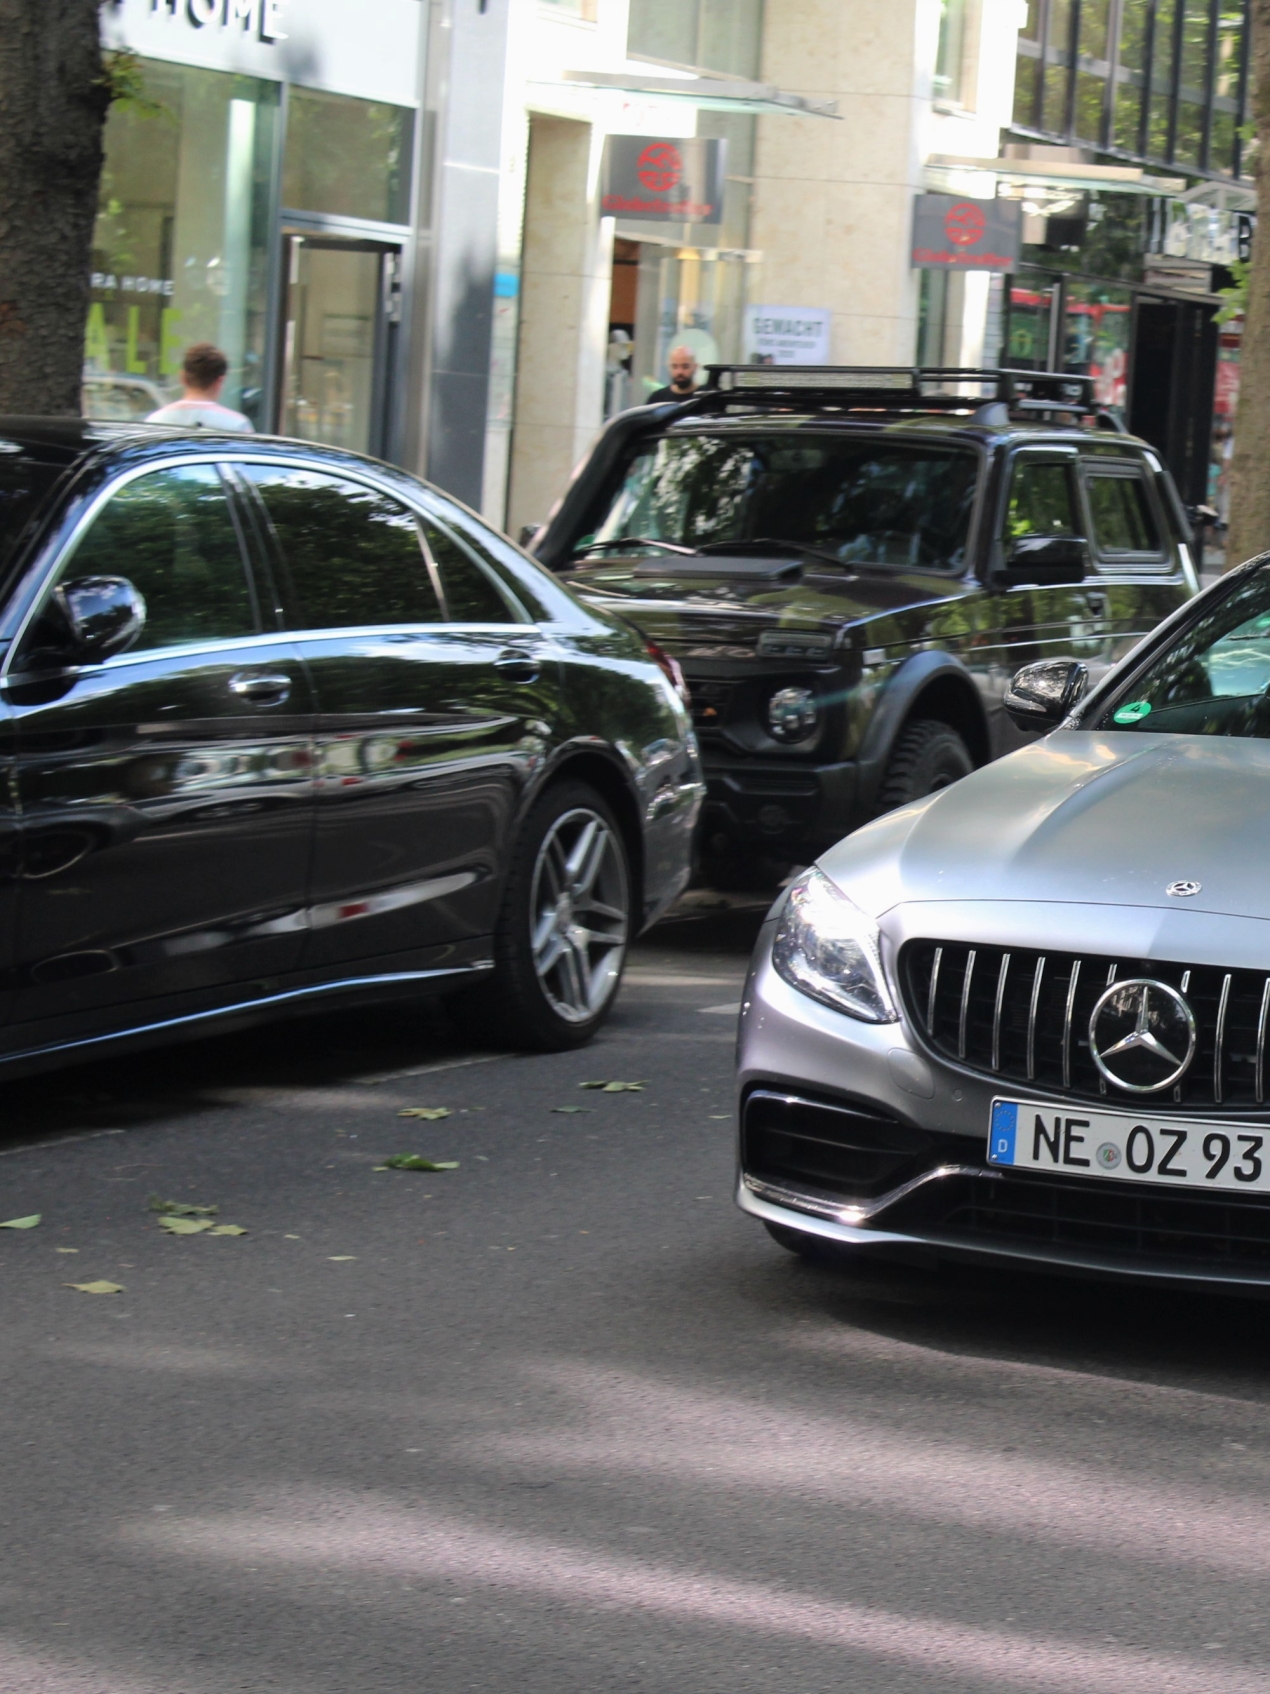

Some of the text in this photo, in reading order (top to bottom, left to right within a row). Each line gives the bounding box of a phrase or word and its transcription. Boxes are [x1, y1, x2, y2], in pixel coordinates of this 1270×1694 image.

[121, 276, 175, 296] HOME
[752, 317, 824, 338] GEMACHT
[84, 302, 183, 375] ALE
[997, 1138, 1008, 1153] D
[1032, 1113, 1264, 1183] NE OZ 93
